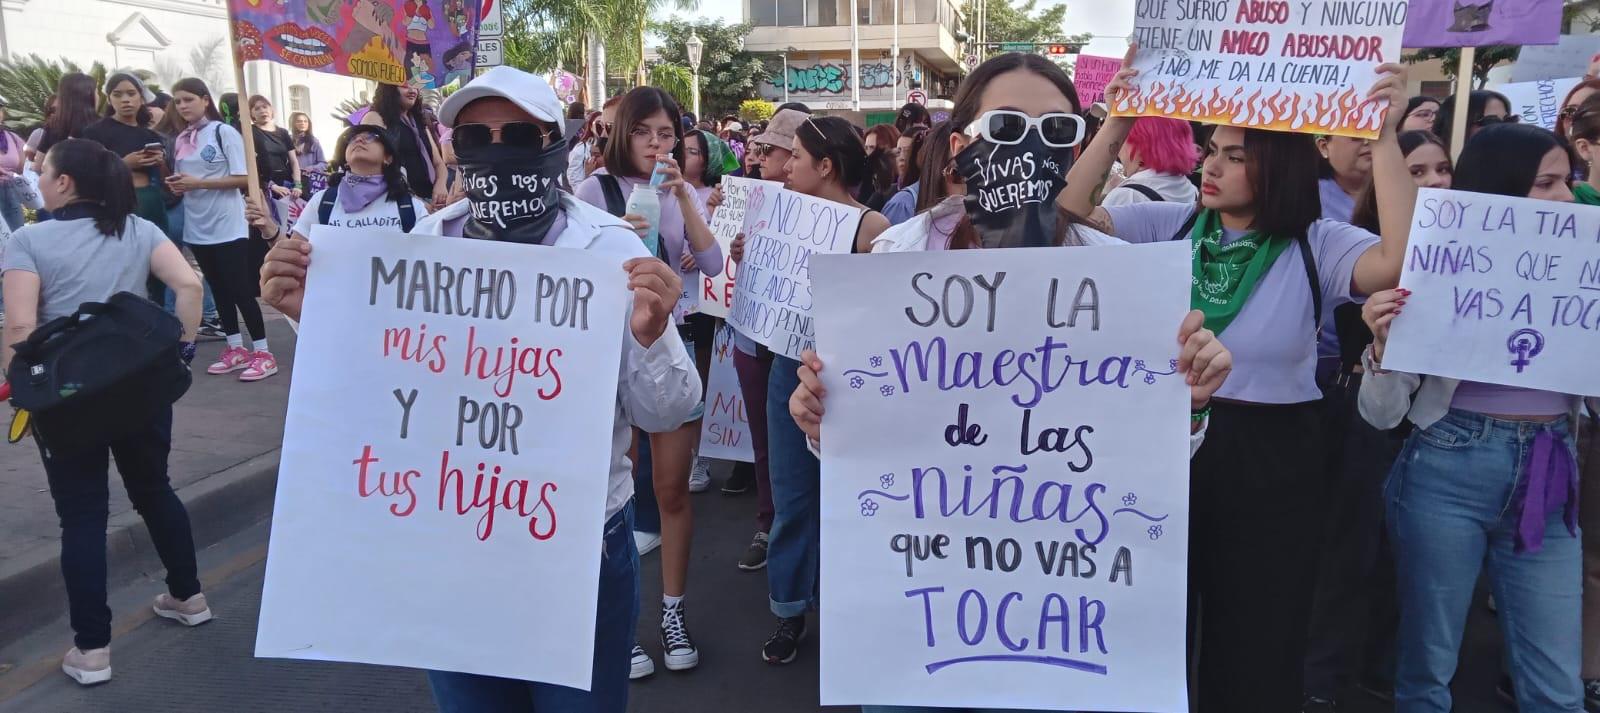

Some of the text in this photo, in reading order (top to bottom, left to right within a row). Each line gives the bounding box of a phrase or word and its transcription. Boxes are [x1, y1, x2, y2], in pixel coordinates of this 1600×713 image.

[1136, 0, 1168, 19] QUE
[1235, 0, 1289, 24] ABUSO
[1300, 1, 1312, 26] Y
[1320, 1, 1407, 26] NINGUNO
[1136, 26, 1383, 63] TIENE UN AMIGO ABUSADOR
[350, 58, 405, 82] SOMOS FUEGO
[1197, 59, 1223, 79] ME
[1228, 61, 1250, 82] DA
[1257, 61, 1275, 82] LA
[1281, 62, 1351, 87] CUENTA!
[511, 174, 538, 192] nos
[974, 143, 1059, 186] VIVAS NOS
[979, 180, 1053, 212] QUEREMOS
[1419, 198, 1472, 229] SOY
[1482, 206, 1515, 234] LA
[1536, 211, 1576, 239] TIA
[768, 192, 848, 251] NO SOY
[750, 233, 790, 271] PERRO
[790, 244, 811, 280] PA
[1410, 240, 1600, 284] NIÑAS QUE N
[370, 256, 594, 330] MARCHO POR
[904, 271, 1100, 332] SOY LA
[1454, 286, 1504, 320] VAS
[1510, 293, 1532, 325] A
[775, 307, 815, 338] PEND
[384, 324, 562, 400] mis hijas
[889, 336, 1131, 408] Maestra
[393, 388, 523, 455] Y POR
[708, 423, 741, 447] SIN
[944, 403, 1095, 472] de las
[353, 445, 558, 541] tus hijas
[912, 463, 1109, 546] niñas
[890, 533, 1133, 586] que no VAS A
[904, 586, 1108, 655] TOCAR
